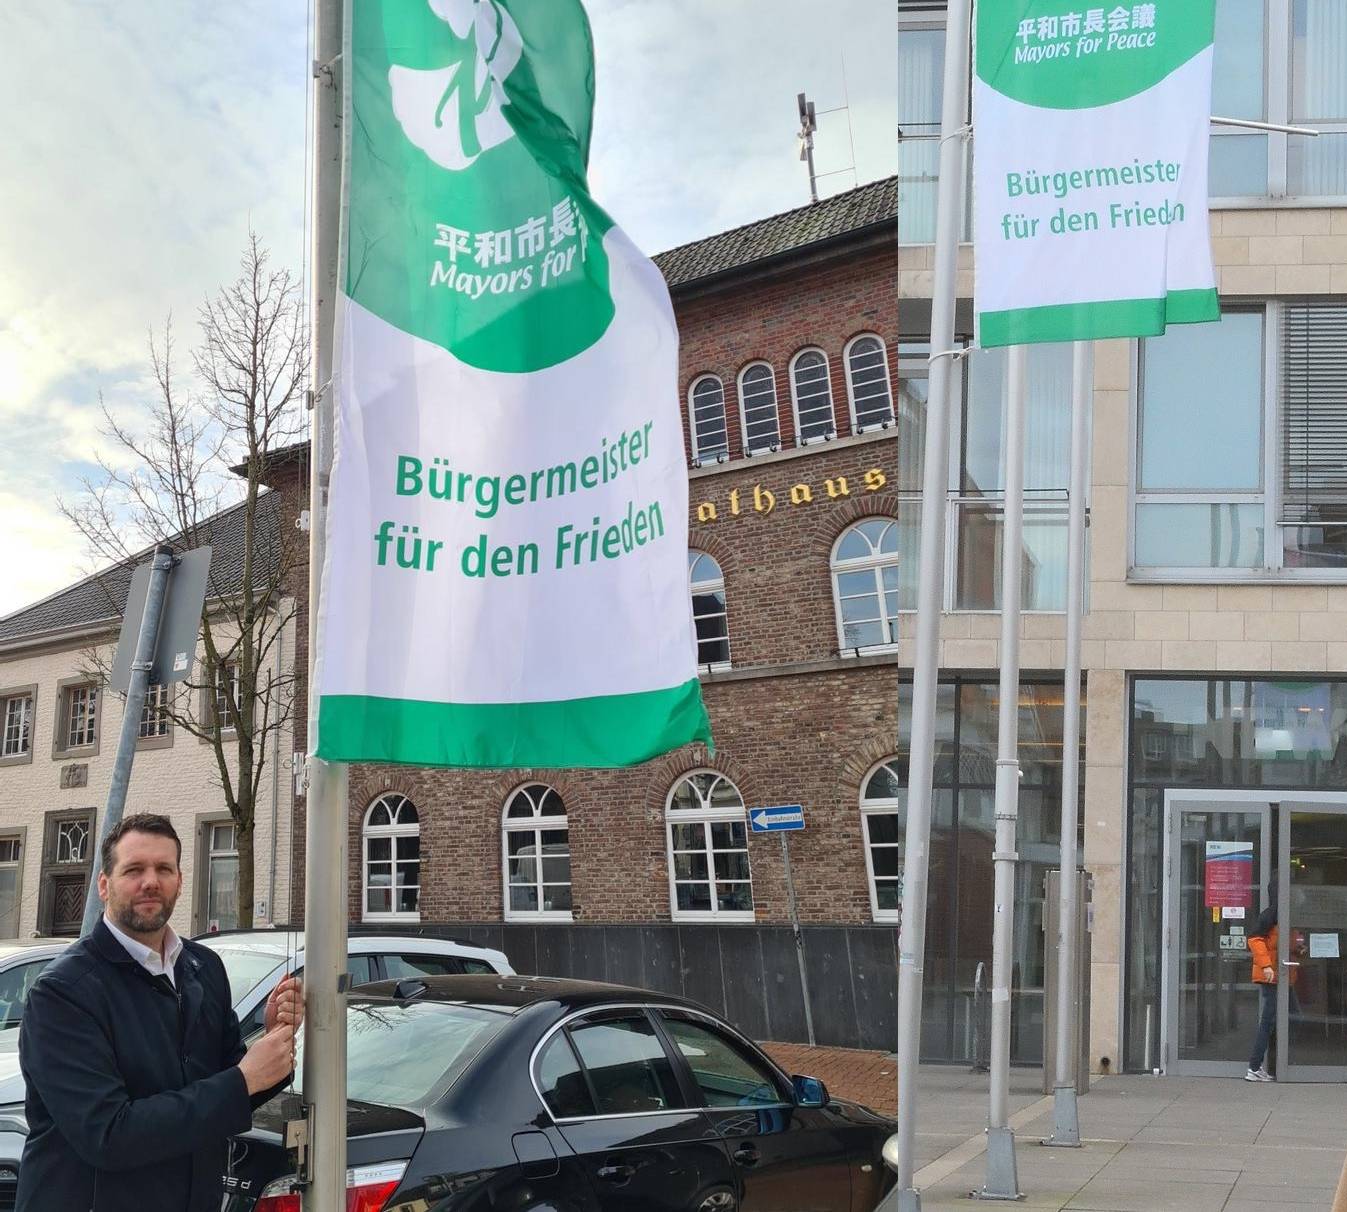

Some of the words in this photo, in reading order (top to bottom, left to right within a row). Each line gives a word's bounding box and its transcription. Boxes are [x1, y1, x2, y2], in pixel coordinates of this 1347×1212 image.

[1014, 41, 1071, 65] Mayors
[1075, 37, 1102, 58] for
[1107, 31, 1157, 51] Peace
[1015, 3, 1156, 44] 平和市長会議
[1006, 158, 1181, 199] Bürgermeister
[433, 195, 587, 268] 平和市長
[1001, 213, 1040, 241] für
[1050, 207, 1099, 234] den
[1110, 199, 1185, 229] Friedn
[430, 261, 533, 299] Mayors
[541, 245, 577, 287] for
[396, 420, 653, 519] Bürgermeister
[697, 468, 887, 522] athaus
[374, 520, 443, 572] für
[461, 534, 539, 578] den
[555, 500, 665, 570] Frieden
